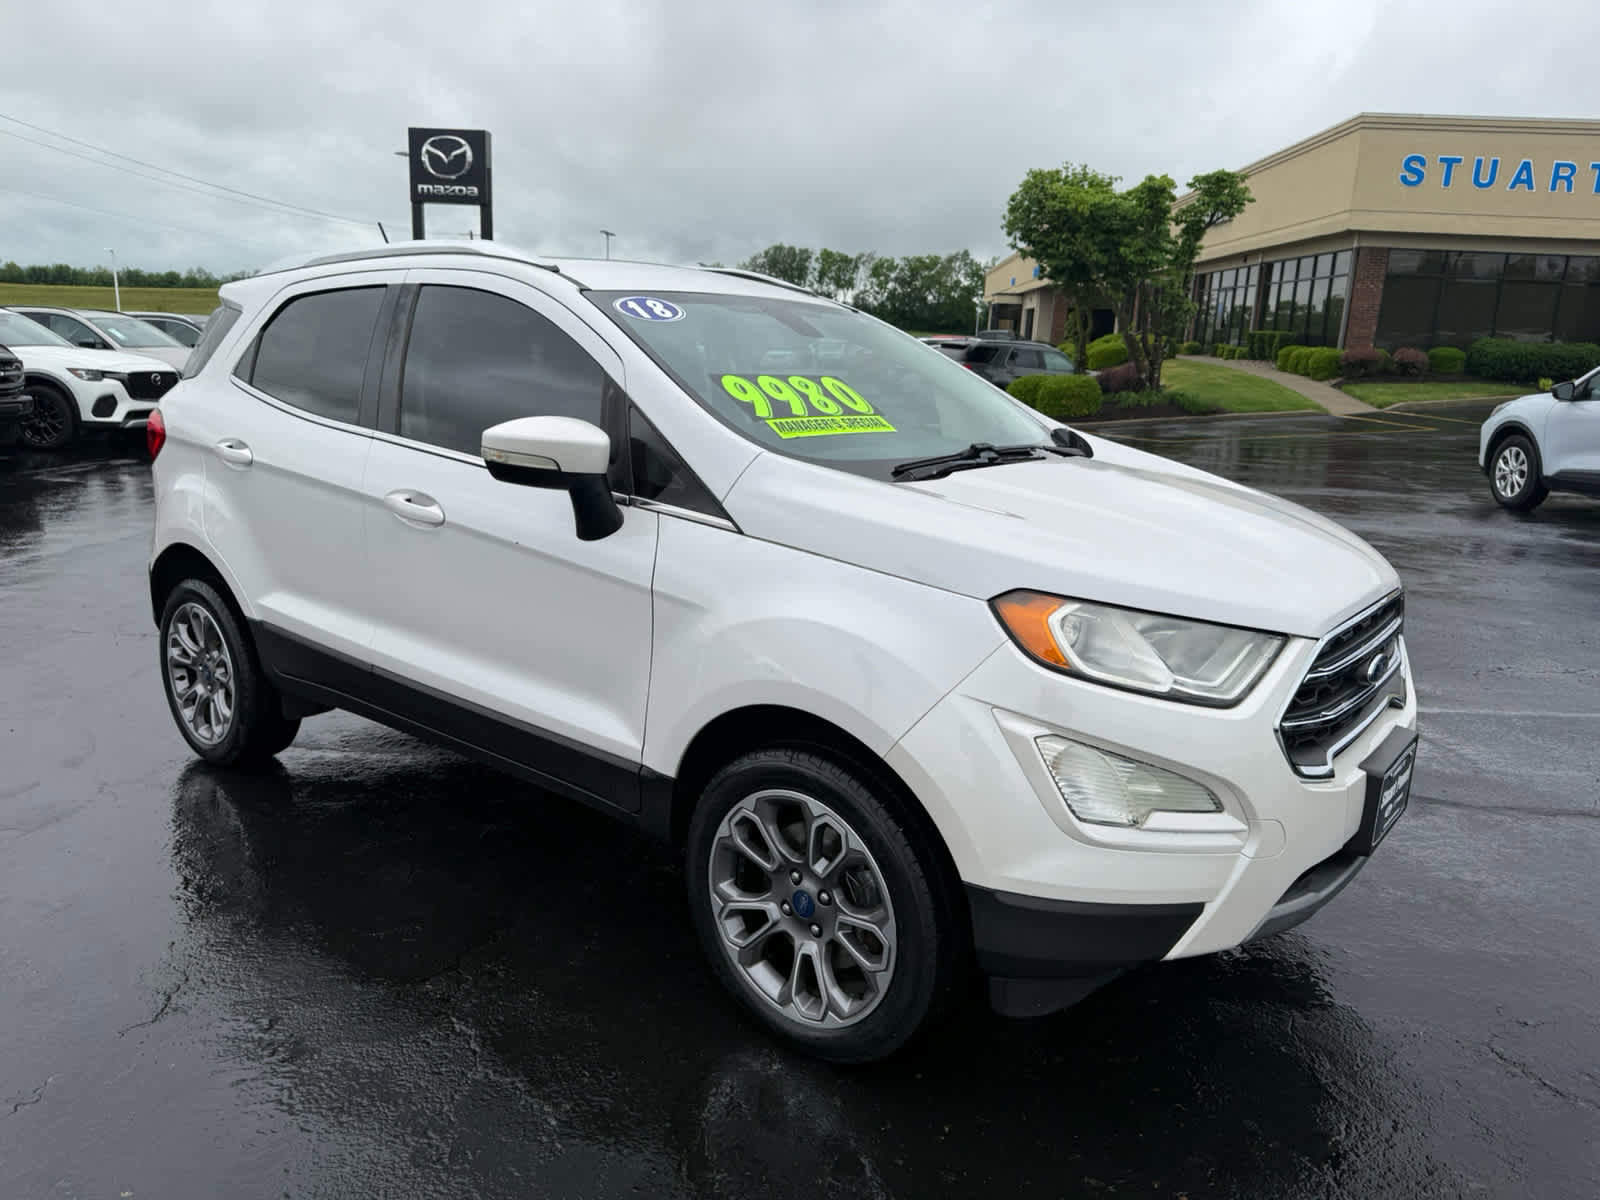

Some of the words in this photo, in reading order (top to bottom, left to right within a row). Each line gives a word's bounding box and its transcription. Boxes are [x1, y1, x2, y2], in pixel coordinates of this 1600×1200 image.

[417, 183, 479, 197] mazda
[626, 299, 673, 319] 18
[721, 375, 874, 418] 9980
[840, 417, 888, 429] SPECIAL
